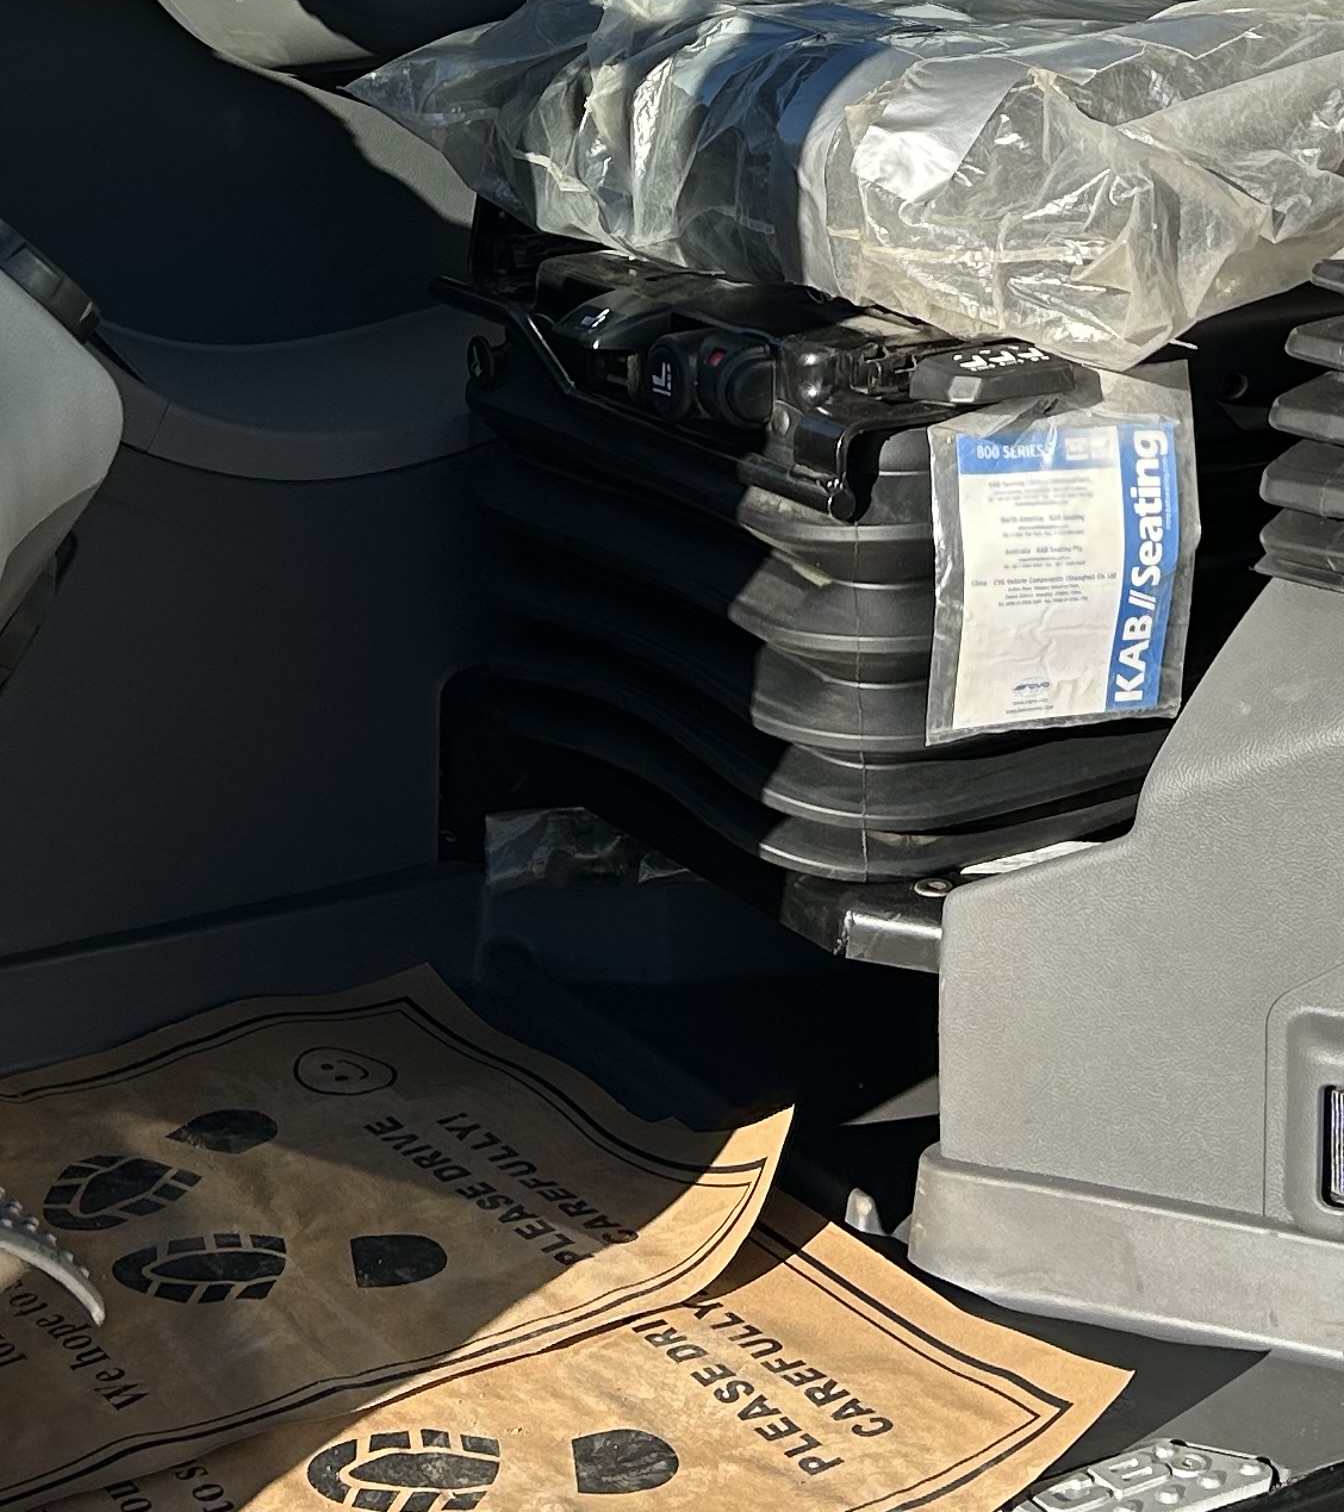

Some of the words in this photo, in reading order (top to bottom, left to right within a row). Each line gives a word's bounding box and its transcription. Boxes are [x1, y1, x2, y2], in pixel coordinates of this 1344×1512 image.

[976, 445, 999, 460] 800
[1131, 430, 1168, 586] Seating
[1114, 615, 1153, 702] KAB
[363, 1116, 473, 1183] DRIVE
[436, 1112, 640, 1244] CAREFULLY!
[456, 1181, 595, 1266] PLEASE
[35, 1314, 113, 1371] hope
[94, 1367, 150, 1411] We
[689, 1363, 845, 1476] PLEASE
